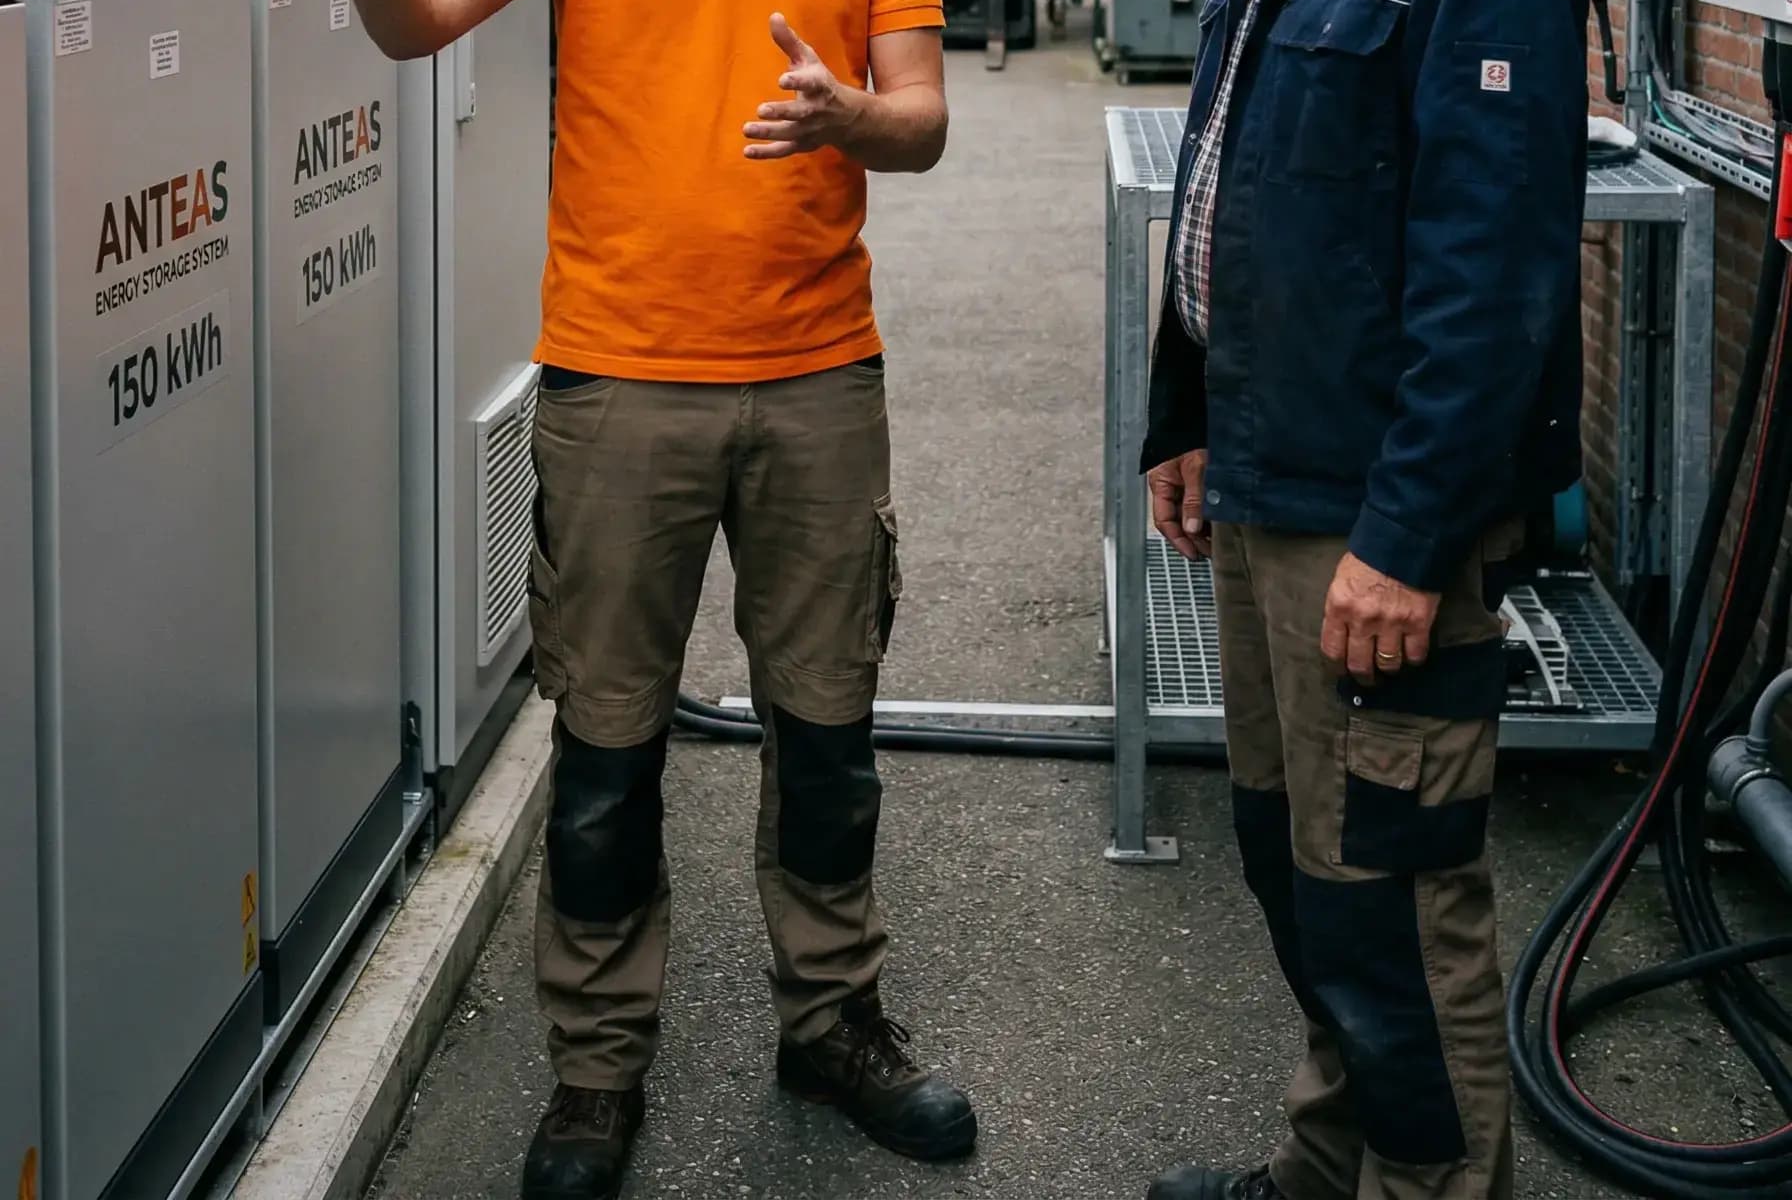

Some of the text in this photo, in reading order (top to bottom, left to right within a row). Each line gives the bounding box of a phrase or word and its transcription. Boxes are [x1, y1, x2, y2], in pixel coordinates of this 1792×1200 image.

[294, 100, 381, 185] ANTEAS
[95, 160, 229, 274] ANTEAS
[95, 234, 230, 316] ENERGY STORAGE SYSTEM
[302, 224, 376, 306] 150 kWh
[108, 312, 222, 426] 150 kWh
